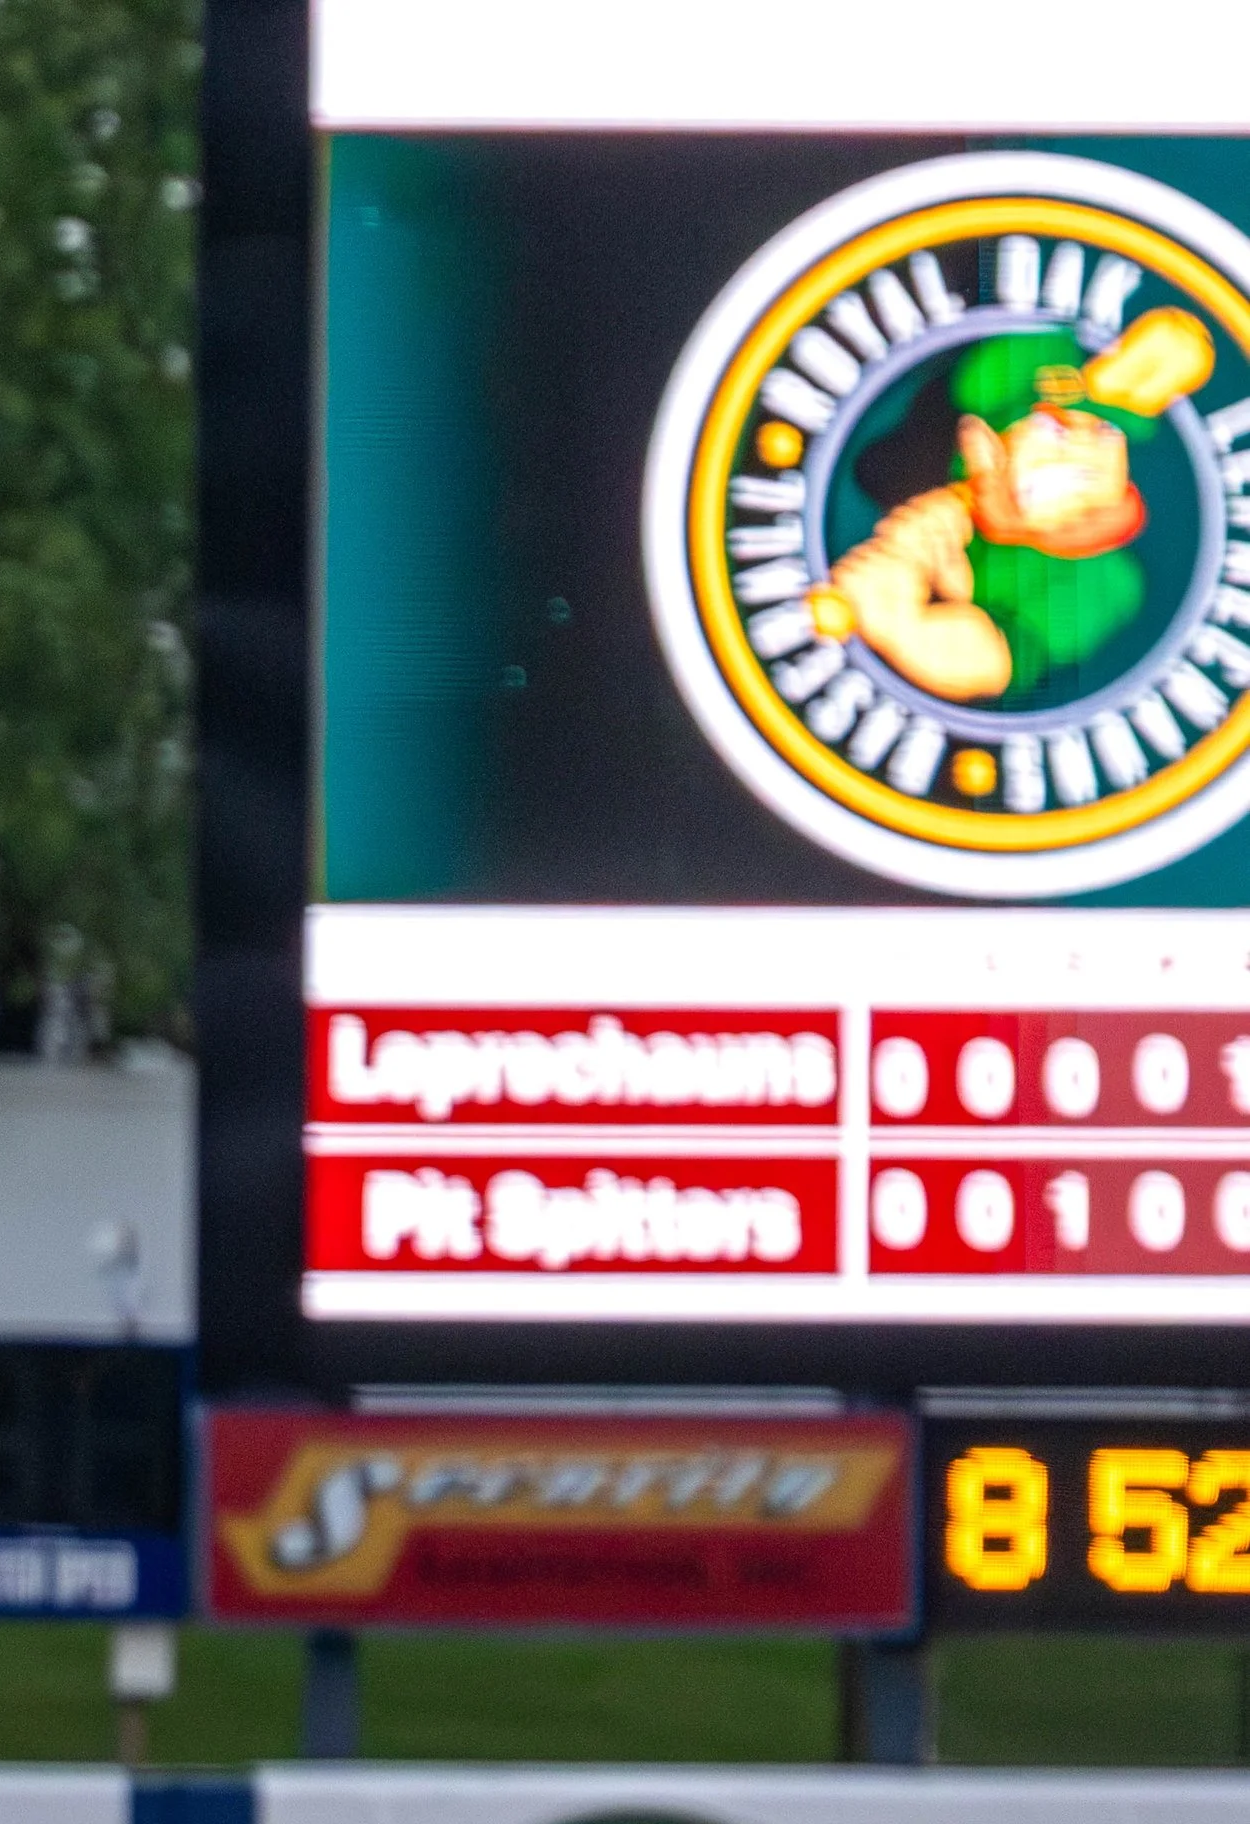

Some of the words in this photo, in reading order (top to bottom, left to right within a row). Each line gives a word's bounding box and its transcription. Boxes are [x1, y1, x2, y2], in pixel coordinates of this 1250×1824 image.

[873, 1036, 929, 1119] 0
[957, 1036, 1016, 1120] 0
[1043, 1036, 1101, 1119] 0
[1131, 1032, 1190, 1115] 0
[873, 1166, 928, 1251] 0
[956, 1168, 1015, 1252] 0
[1044, 1170, 1090, 1252] 1
[1128, 1170, 1186, 1252] 0
[945, 1447, 1049, 1590] 8
